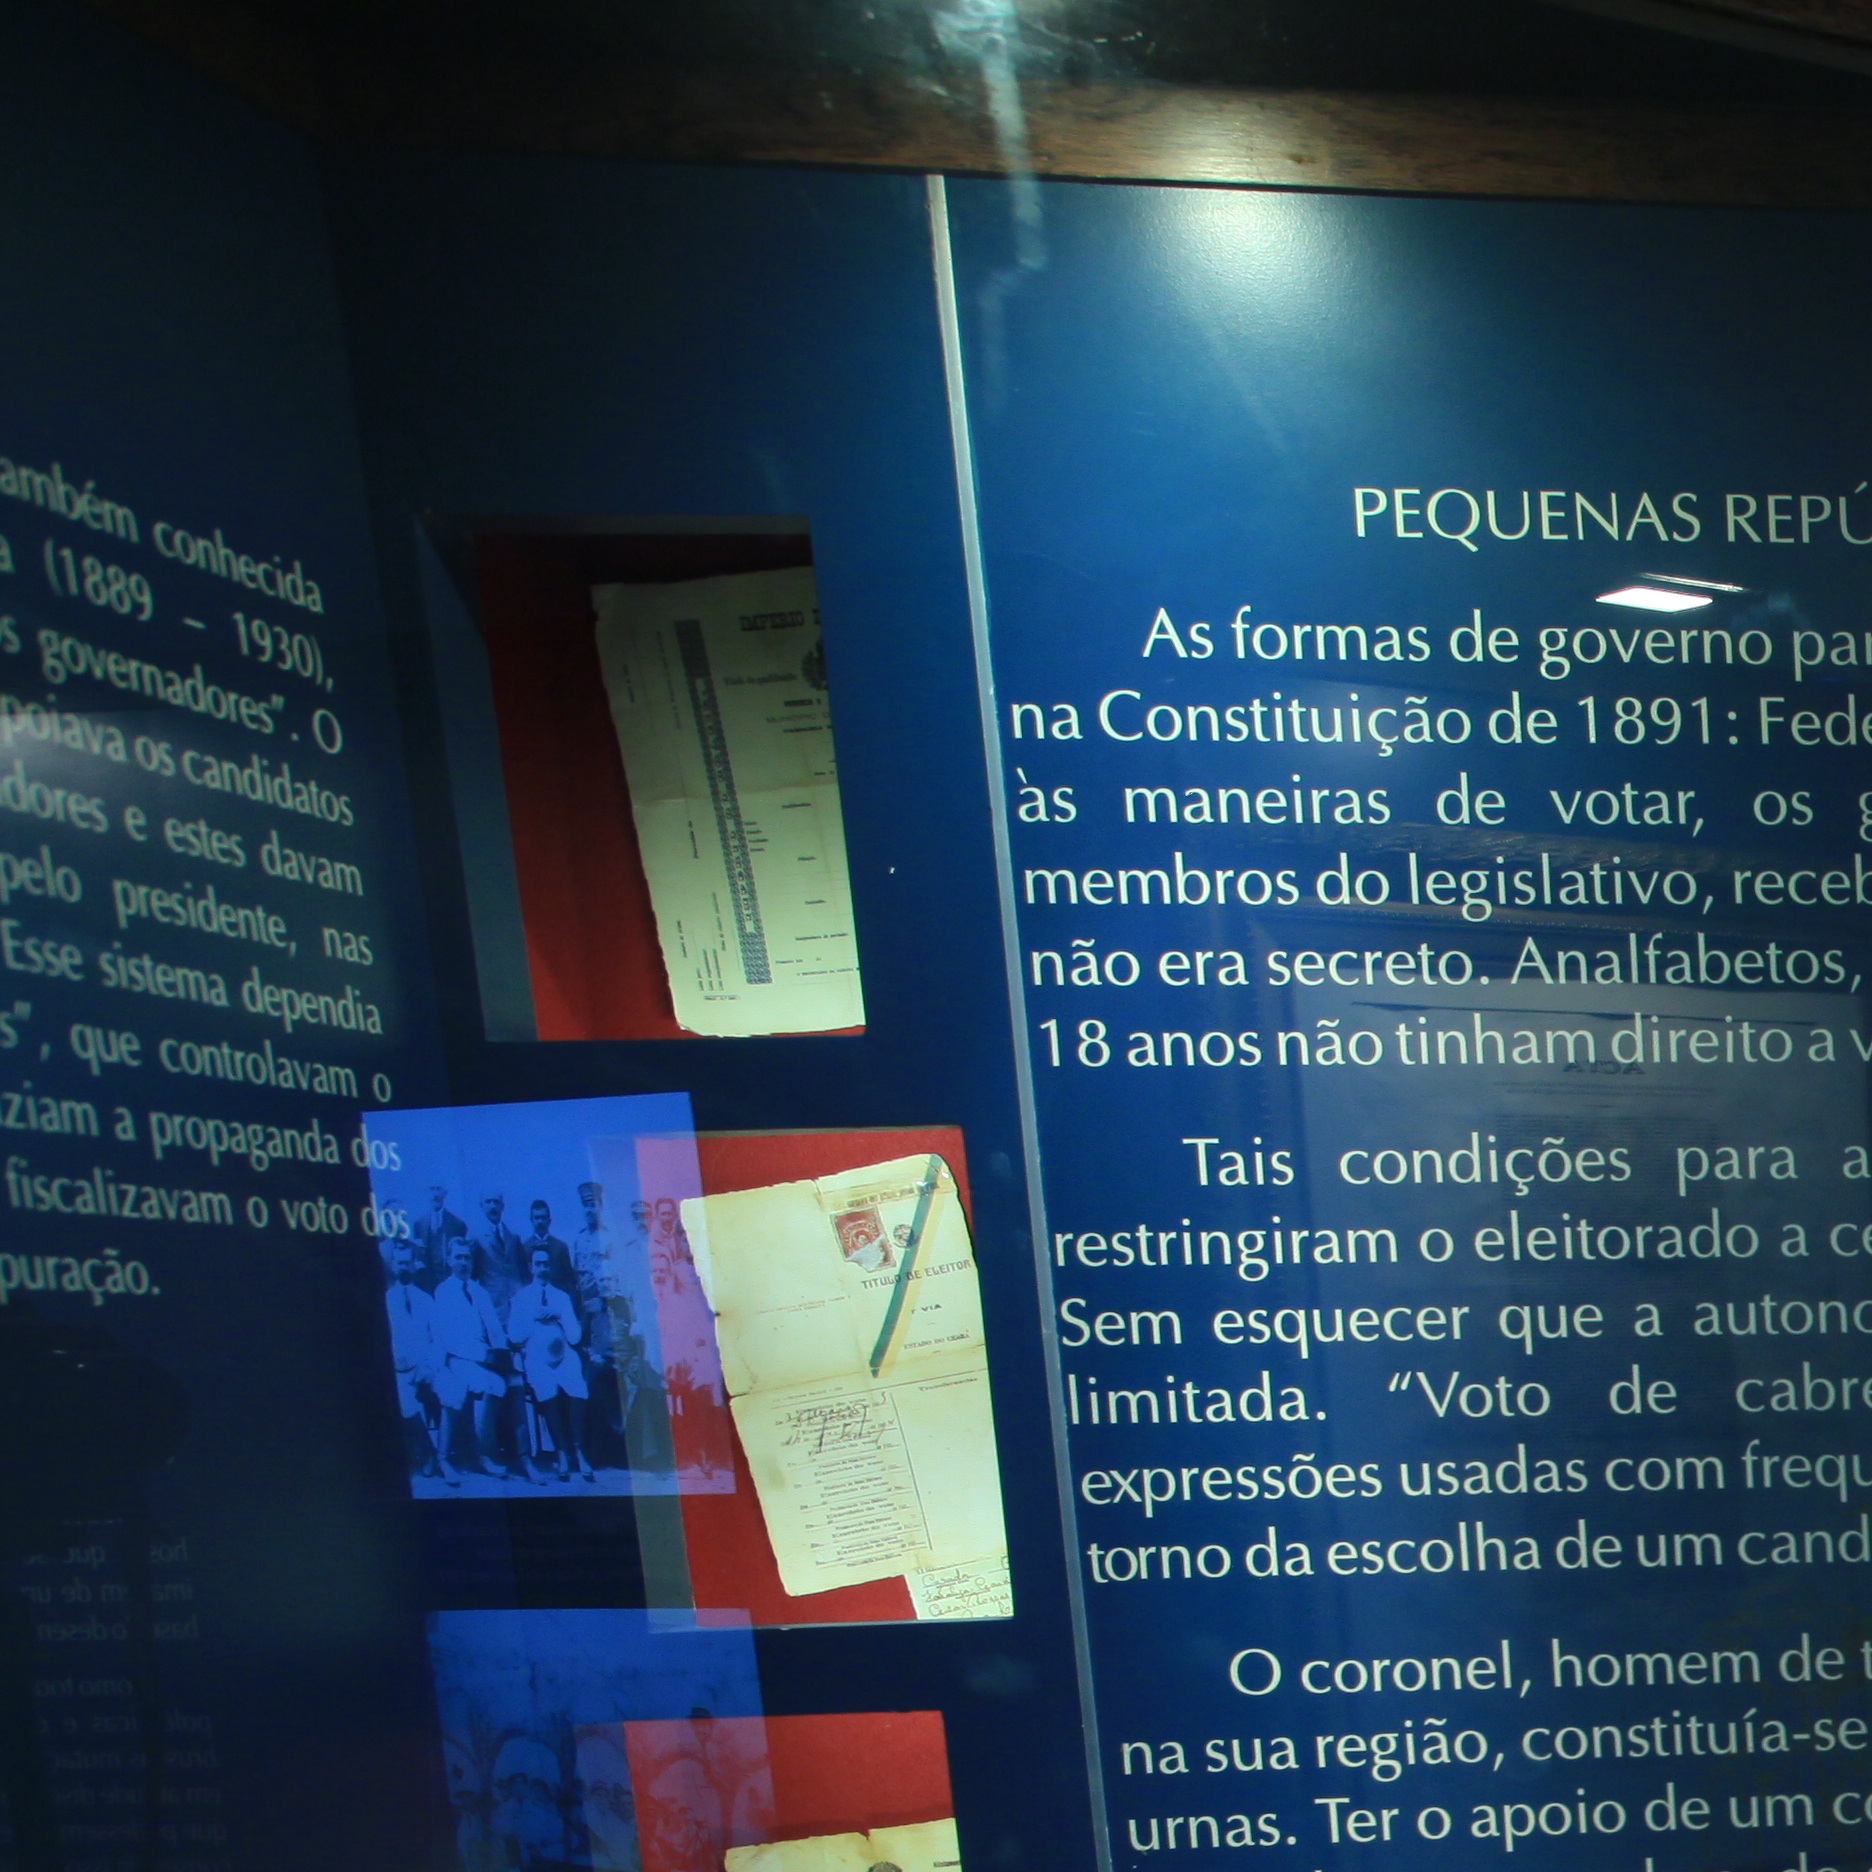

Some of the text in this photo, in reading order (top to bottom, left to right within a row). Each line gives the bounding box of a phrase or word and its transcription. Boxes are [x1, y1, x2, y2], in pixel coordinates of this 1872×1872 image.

[1353, 486, 1702, 554] PEQUENAS
[153, 521, 325, 613] conhecida
[44, 537, 154, 621] (1889
[232, 611, 333, 693] 1930),
[312, 708, 342, 755] O
[1010, 702, 1085, 742] na
[1097, 688, 1473, 759] Constituição
[1487, 689, 1559, 746] de
[1576, 694, 1740, 746] 1891:
[135, 735, 177, 778] os
[182, 750, 355, 827] candidatos
[124, 805, 148, 842] e
[164, 817, 246, 868] estes
[260, 829, 364, 897] davam
[1023, 850, 1301, 907] membros
[1315, 851, 1391, 907] do
[1407, 851, 1715, 924] legislativo,
[0, 844, 374, 967] pelo presidente, nas
[1, 918, 383, 1035] Esse sistema dependia
[70, 1023, 392, 1103] que controlavam o
[113, 1105, 136, 1142] a
[149, 1111, 341, 1172] propaganda
[350, 1122, 401, 1172] dos
[6, 1155, 411, 1239] fiscalizavam o voto dos
[1085, 1541, 1233, 1585] torno
[1244, 1524, 1316, 1579] da
[1326, 1519, 1543, 1577] escolha
[1554, 1517, 1624, 1571] de
[1635, 1532, 1724, 1569] um
